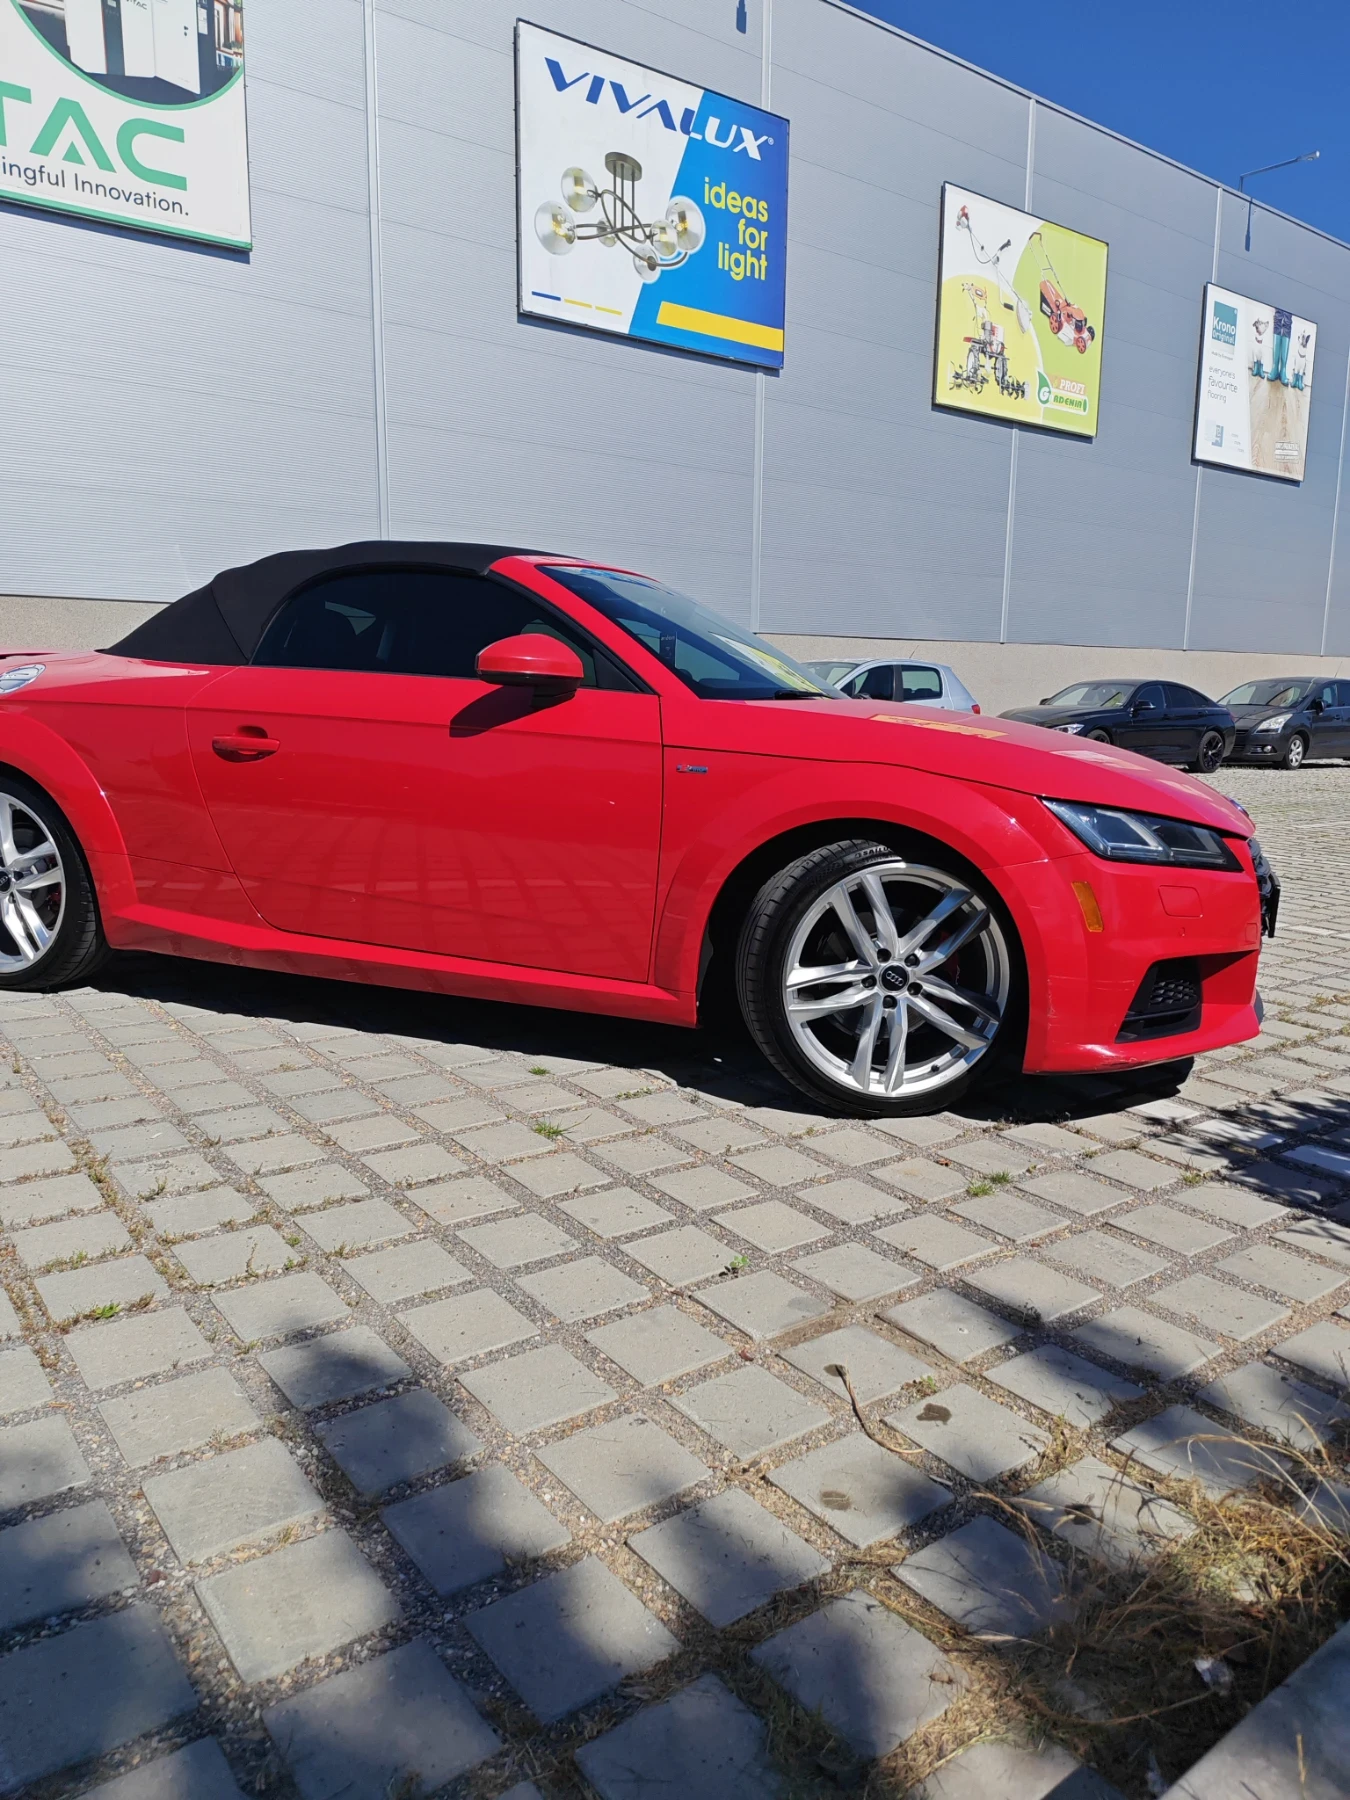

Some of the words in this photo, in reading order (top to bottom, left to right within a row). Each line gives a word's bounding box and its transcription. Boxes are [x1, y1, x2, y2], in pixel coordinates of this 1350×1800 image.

[74, 171, 190, 217] Innovation.
[704, 176, 769, 223] ideas
[738, 219, 768, 251] for
[717, 241, 768, 281] light
[1213, 316, 1236, 335] Krono
[1212, 329, 1235, 345] Original
[1059, 379, 1086, 395] PROFI
[1208, 375, 1238, 393] favourite
[1207, 389, 1227, 404] flooring
